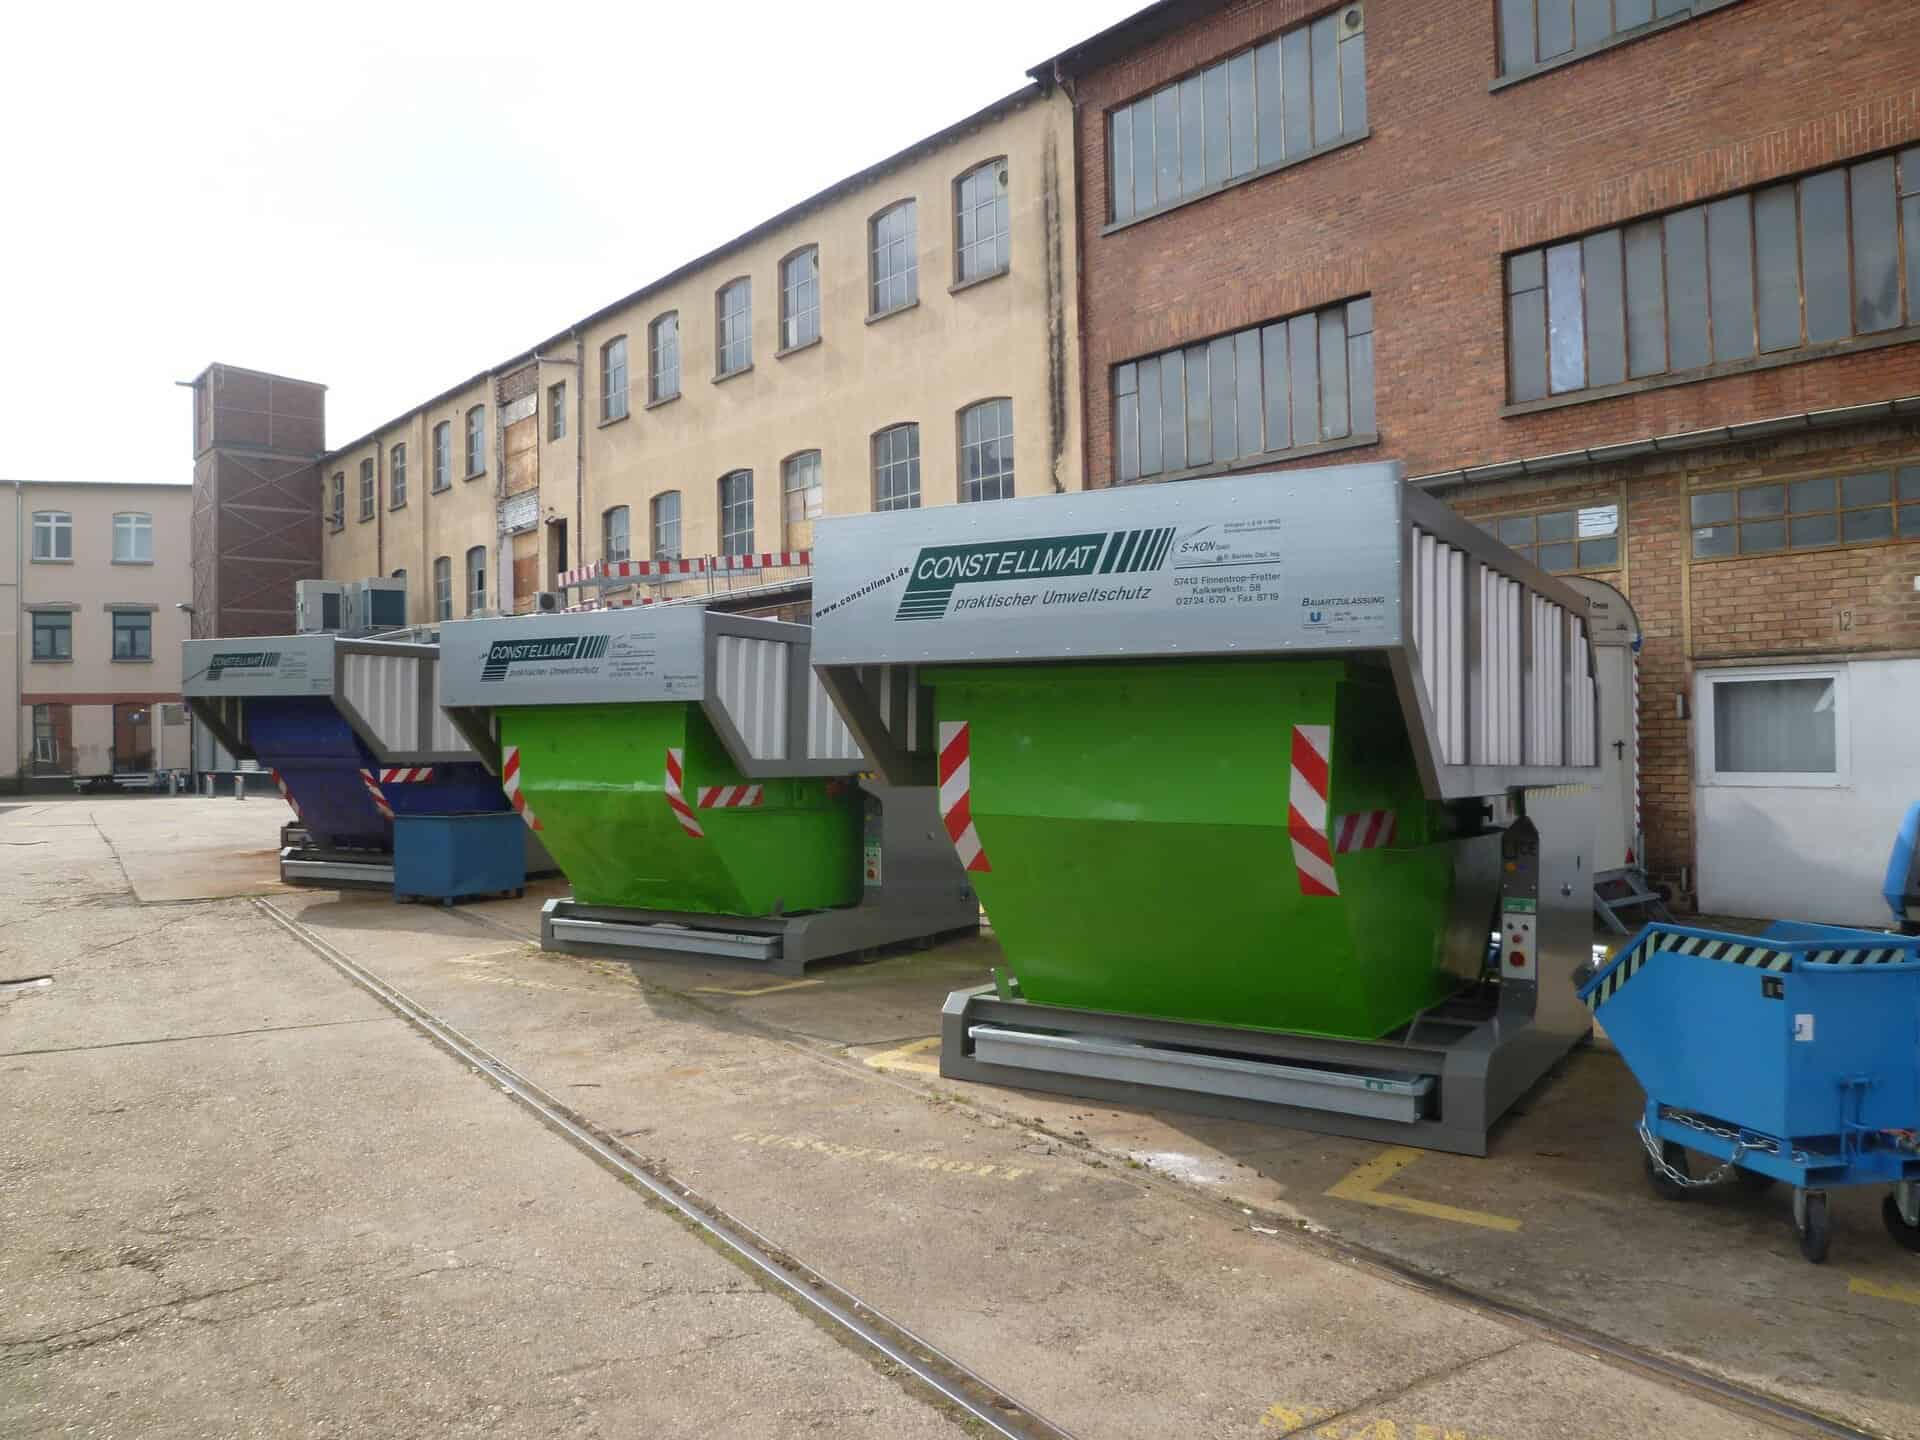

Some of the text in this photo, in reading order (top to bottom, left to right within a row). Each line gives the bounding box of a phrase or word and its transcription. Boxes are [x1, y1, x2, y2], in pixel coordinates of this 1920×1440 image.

[1180, 541, 1216, 553] S-KON
[917, 544, 1097, 580] CONSTELLMAT
[815, 566, 911, 618] www.constellmat.de
[954, 585, 1153, 613] praktischer Umweltschutz
[490, 642, 577, 661] CONSTELLMAT
